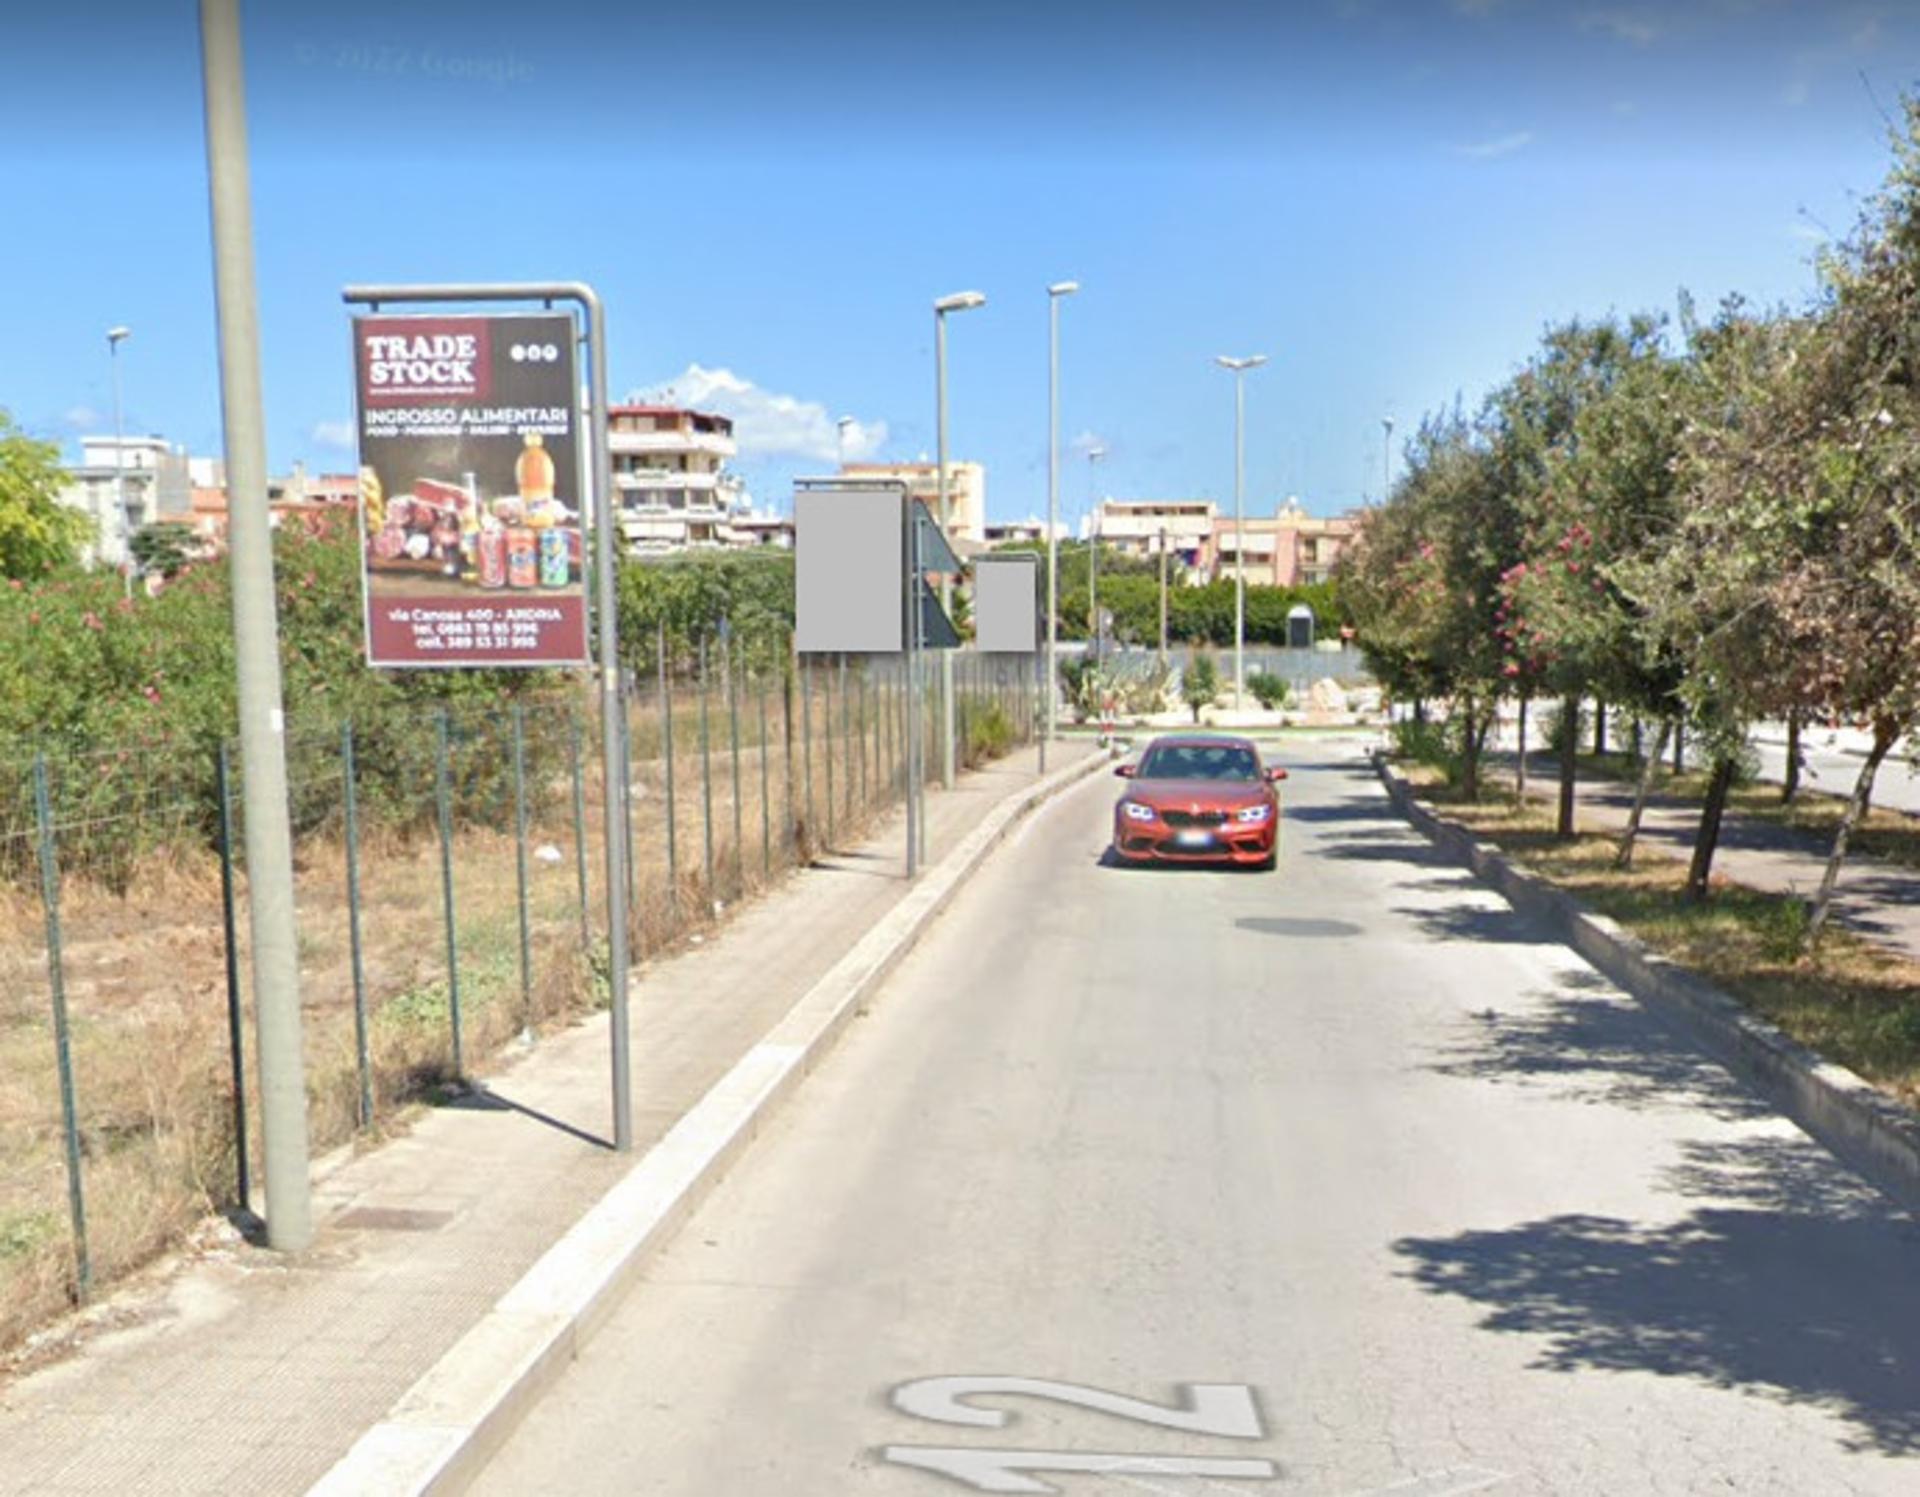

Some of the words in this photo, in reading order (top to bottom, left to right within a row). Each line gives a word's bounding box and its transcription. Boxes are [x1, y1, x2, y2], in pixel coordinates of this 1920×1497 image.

[366, 335, 476, 360] TRADE
[369, 361, 475, 384] STOCK
[366, 408, 457, 424] INGROSSO
[460, 408, 568, 423] ALIMENTARI
[389, 608, 409, 621] via
[506, 608, 562, 620] ANDRIA
